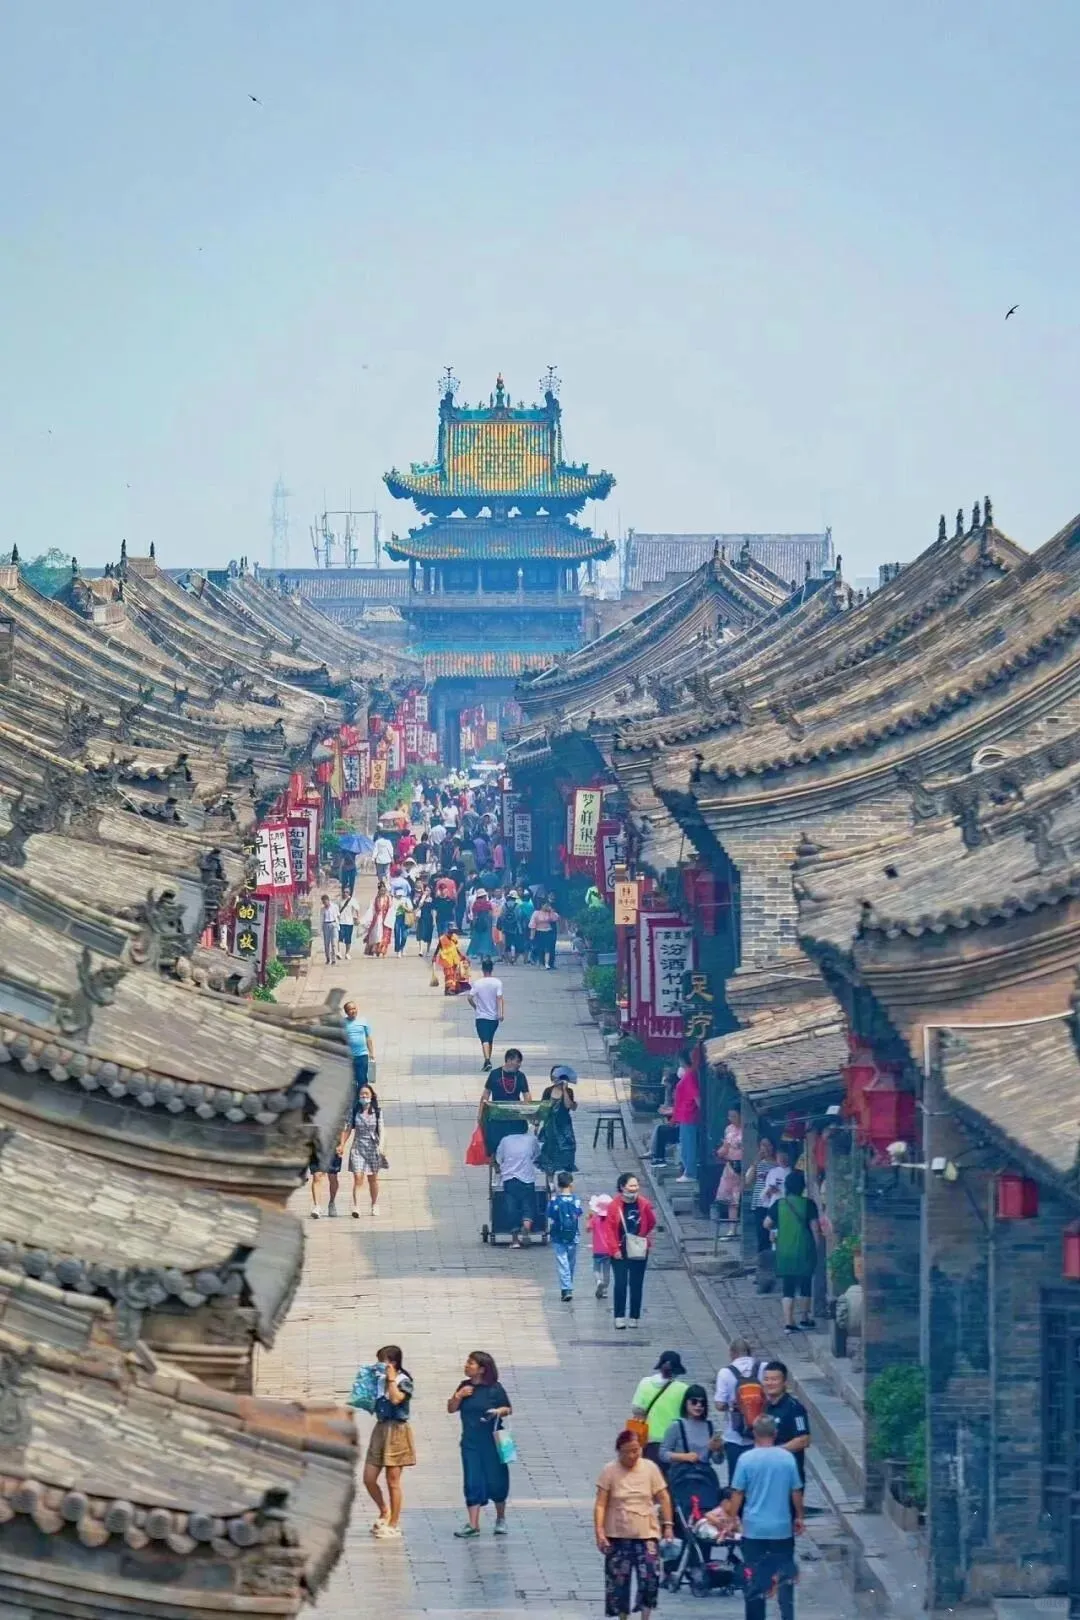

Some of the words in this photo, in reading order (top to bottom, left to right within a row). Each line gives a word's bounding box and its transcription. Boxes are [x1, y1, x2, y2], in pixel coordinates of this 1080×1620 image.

[660, 943, 687, 1013] 汾酒竹叶青
[683, 974, 714, 1039] 足疗
